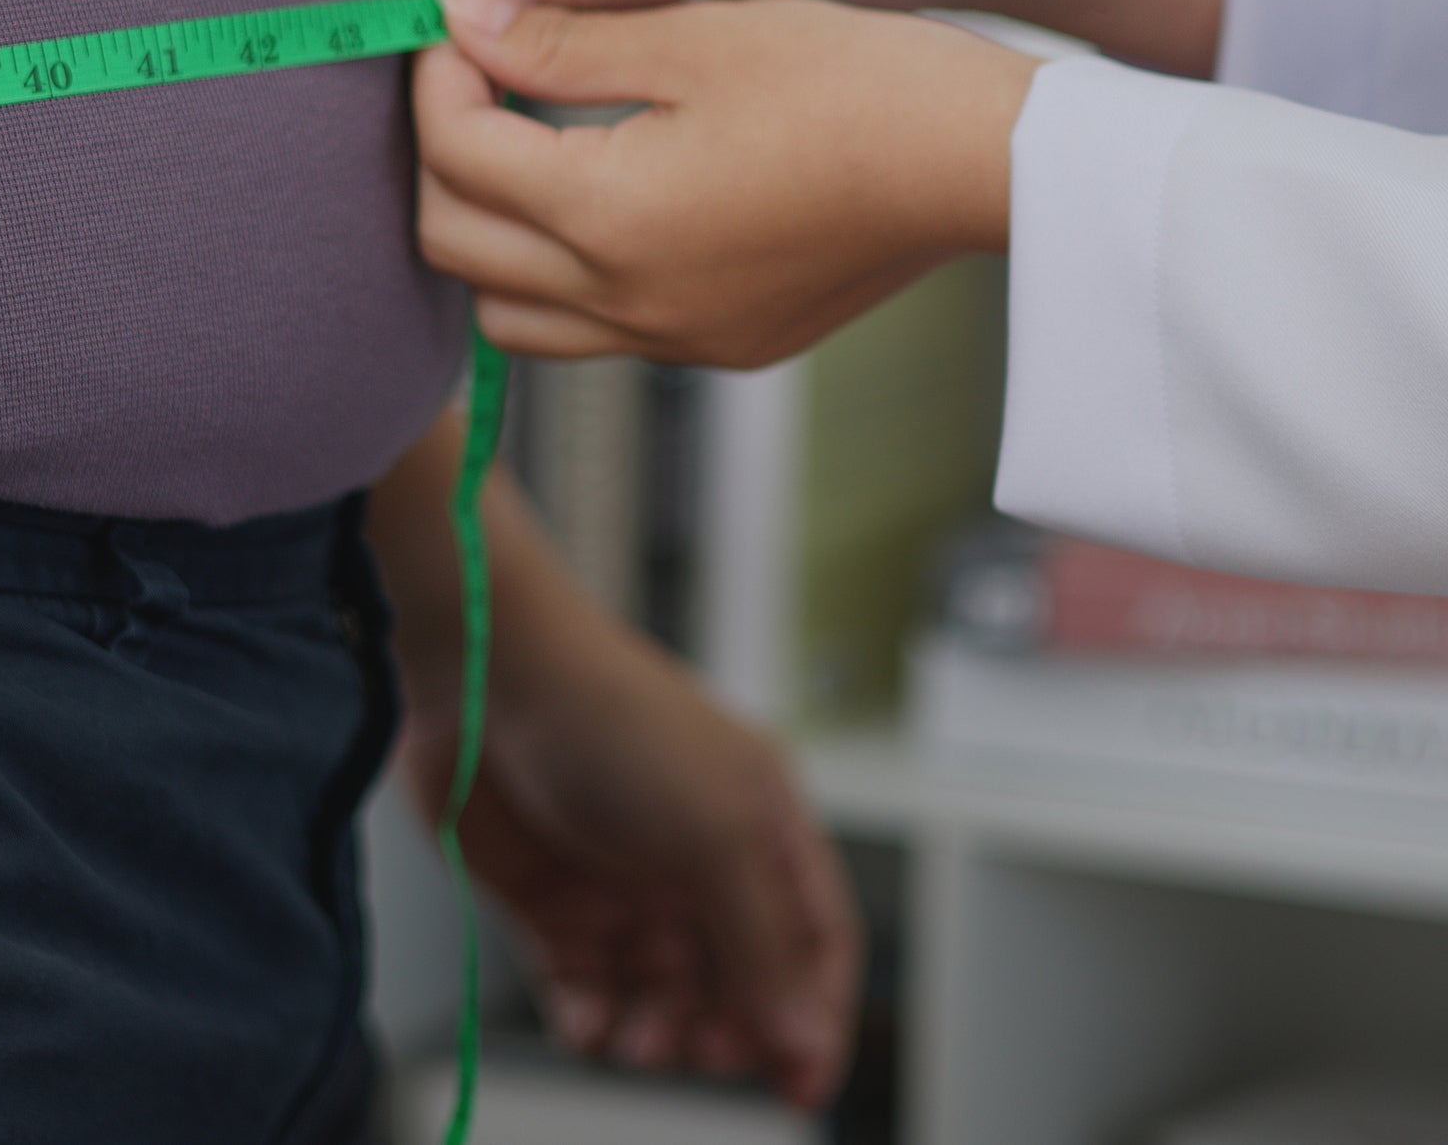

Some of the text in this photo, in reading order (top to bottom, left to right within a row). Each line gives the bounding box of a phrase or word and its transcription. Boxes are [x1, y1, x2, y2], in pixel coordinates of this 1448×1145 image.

[23, 60, 73, 94] 40
[136, 47, 181, 80] 41
[238, 33, 280, 67] 42
